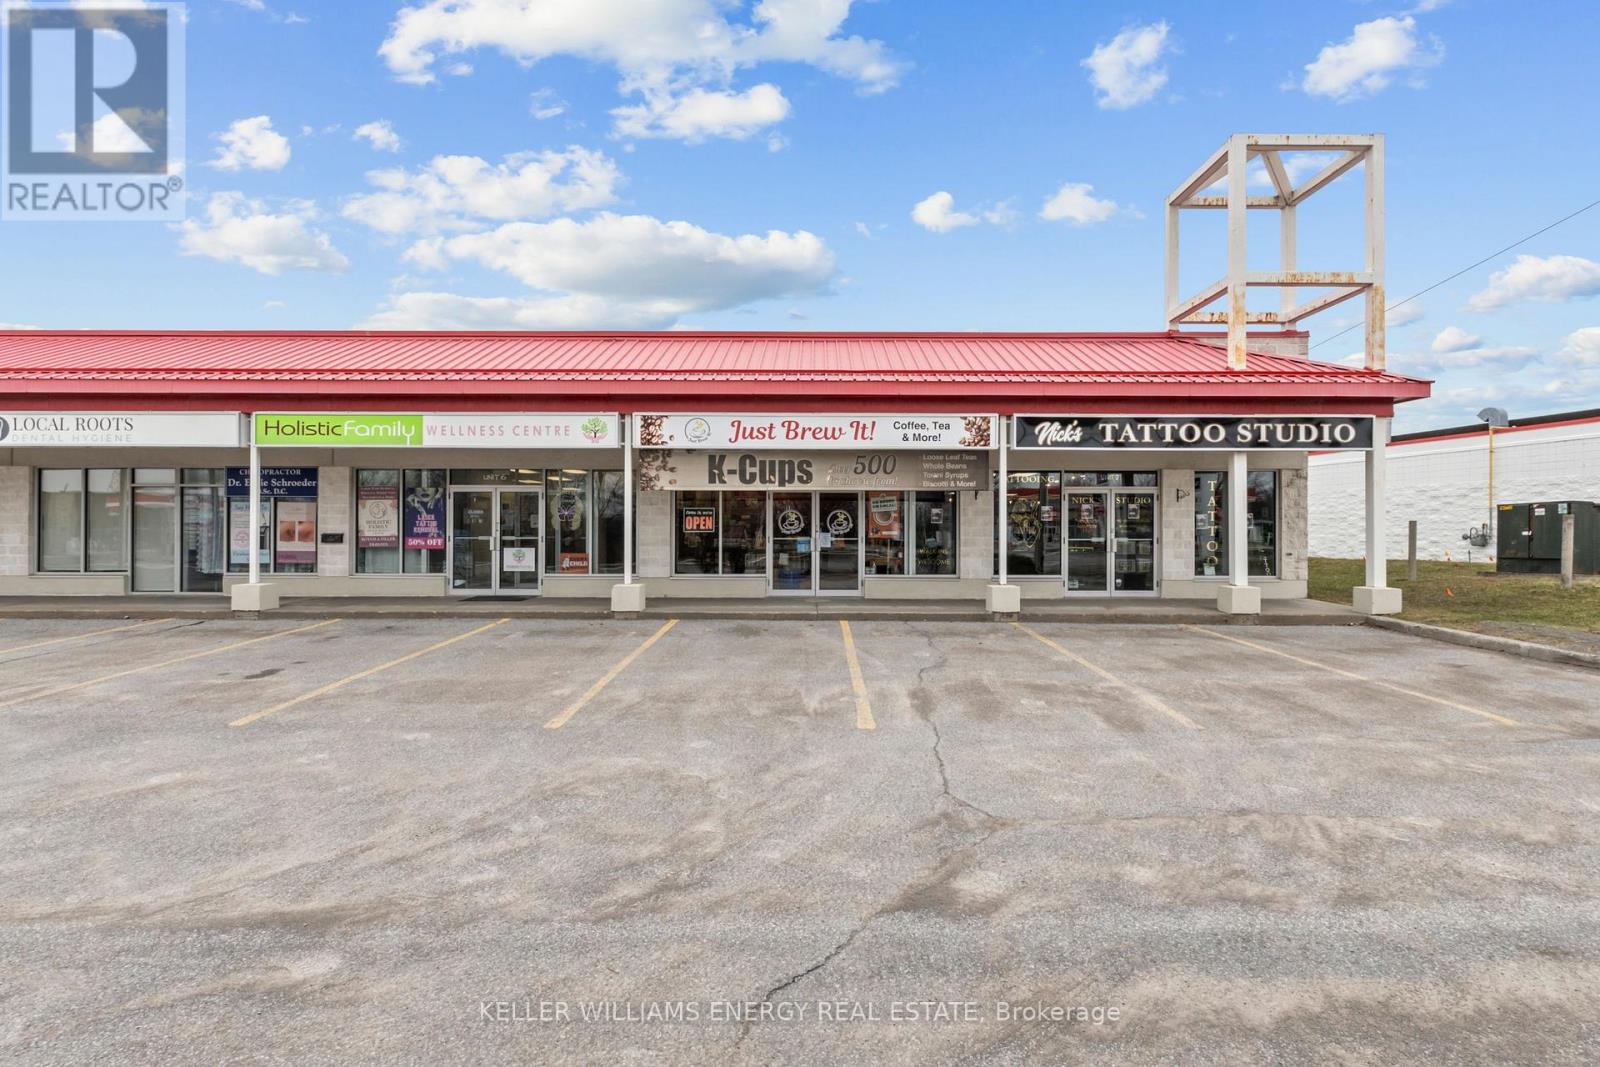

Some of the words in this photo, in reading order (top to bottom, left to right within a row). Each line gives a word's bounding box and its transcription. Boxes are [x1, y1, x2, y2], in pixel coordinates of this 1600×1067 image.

[13, 417, 70, 431] LOCAL
[75, 417, 134, 431] ROOTS
[893, 420, 929, 431] Coffee,
[932, 421, 951, 430] Tea
[427, 425, 505, 436] WELLNESS
[512, 425, 571, 436] CENTRE
[728, 420, 777, 443] Just
[780, 420, 846, 440] Brew
[849, 420, 877, 440] It!
[1035, 420, 1083, 446] Nick's
[1099, 423, 1226, 443] TATTOO
[1236, 423, 1356, 443] STUDIO
[12, 434, 64, 442] DENTAL
[72, 434, 134, 442] HYGIENE
[902, 433, 910, 442] &
[912, 433, 941, 442] More!
[708, 454, 814, 487] K-Cups
[853, 454, 897, 475] 500
[228, 479, 242, 487] Dr.
[271, 479, 317, 487] Schroeder
[1007, 475, 1055, 483] TTOOING
[686, 516, 713, 530] OPEN
[1206, 480, 1218, 566] TATTOO
